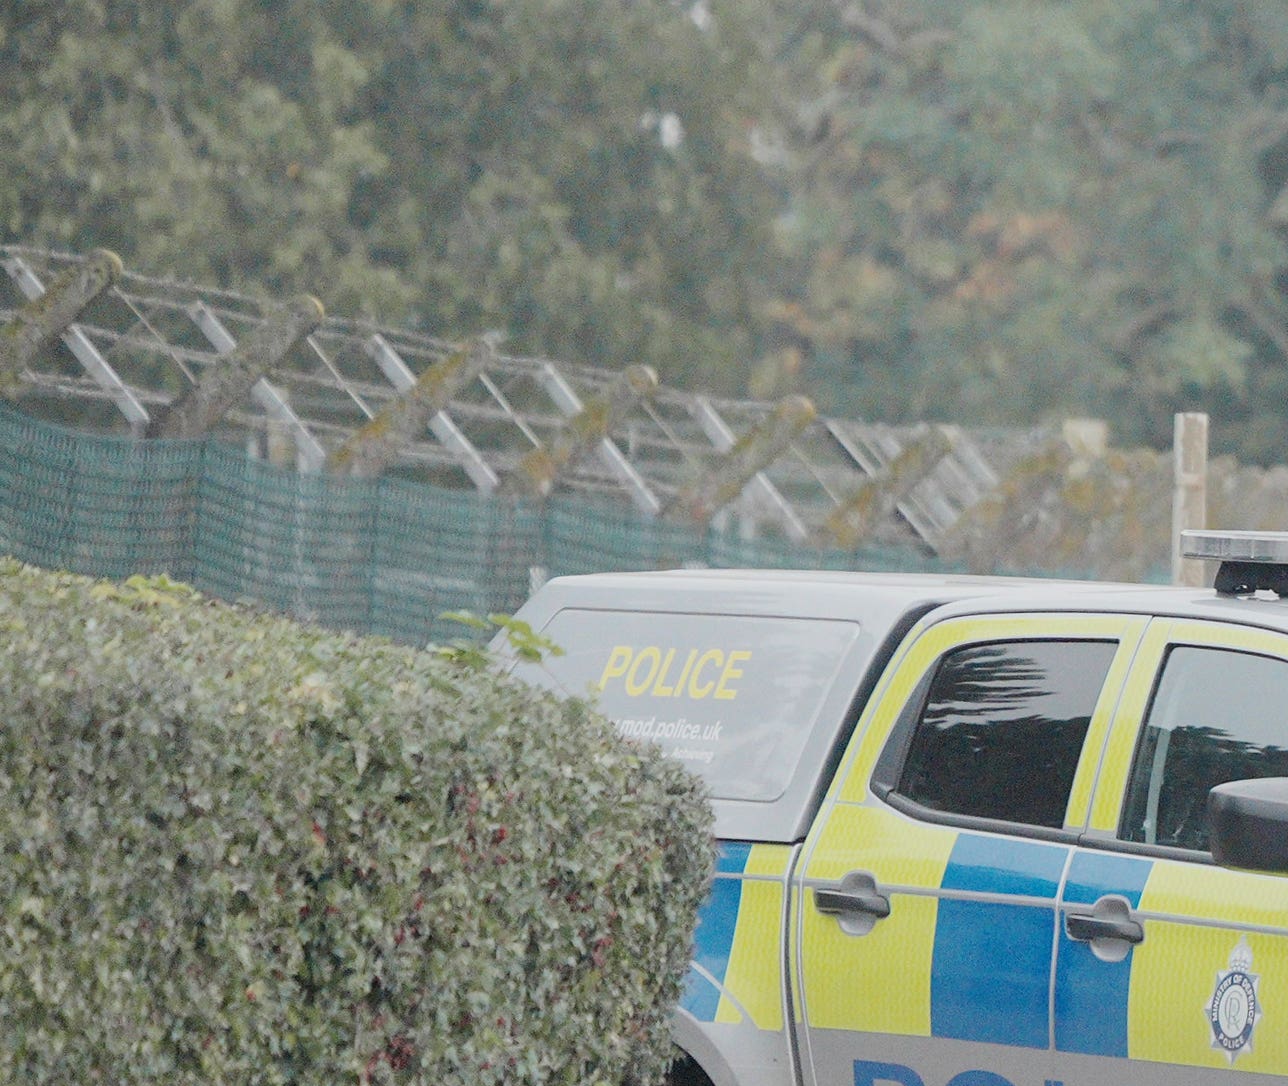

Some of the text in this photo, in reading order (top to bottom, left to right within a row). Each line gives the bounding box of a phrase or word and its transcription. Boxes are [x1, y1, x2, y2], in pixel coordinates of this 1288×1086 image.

[599, 645, 753, 700] POLICE
[1212, 975, 1233, 1022] MINISTRY
[1233, 974, 1243, 984] OF
[1219, 1033, 1245, 1049] POLICE
